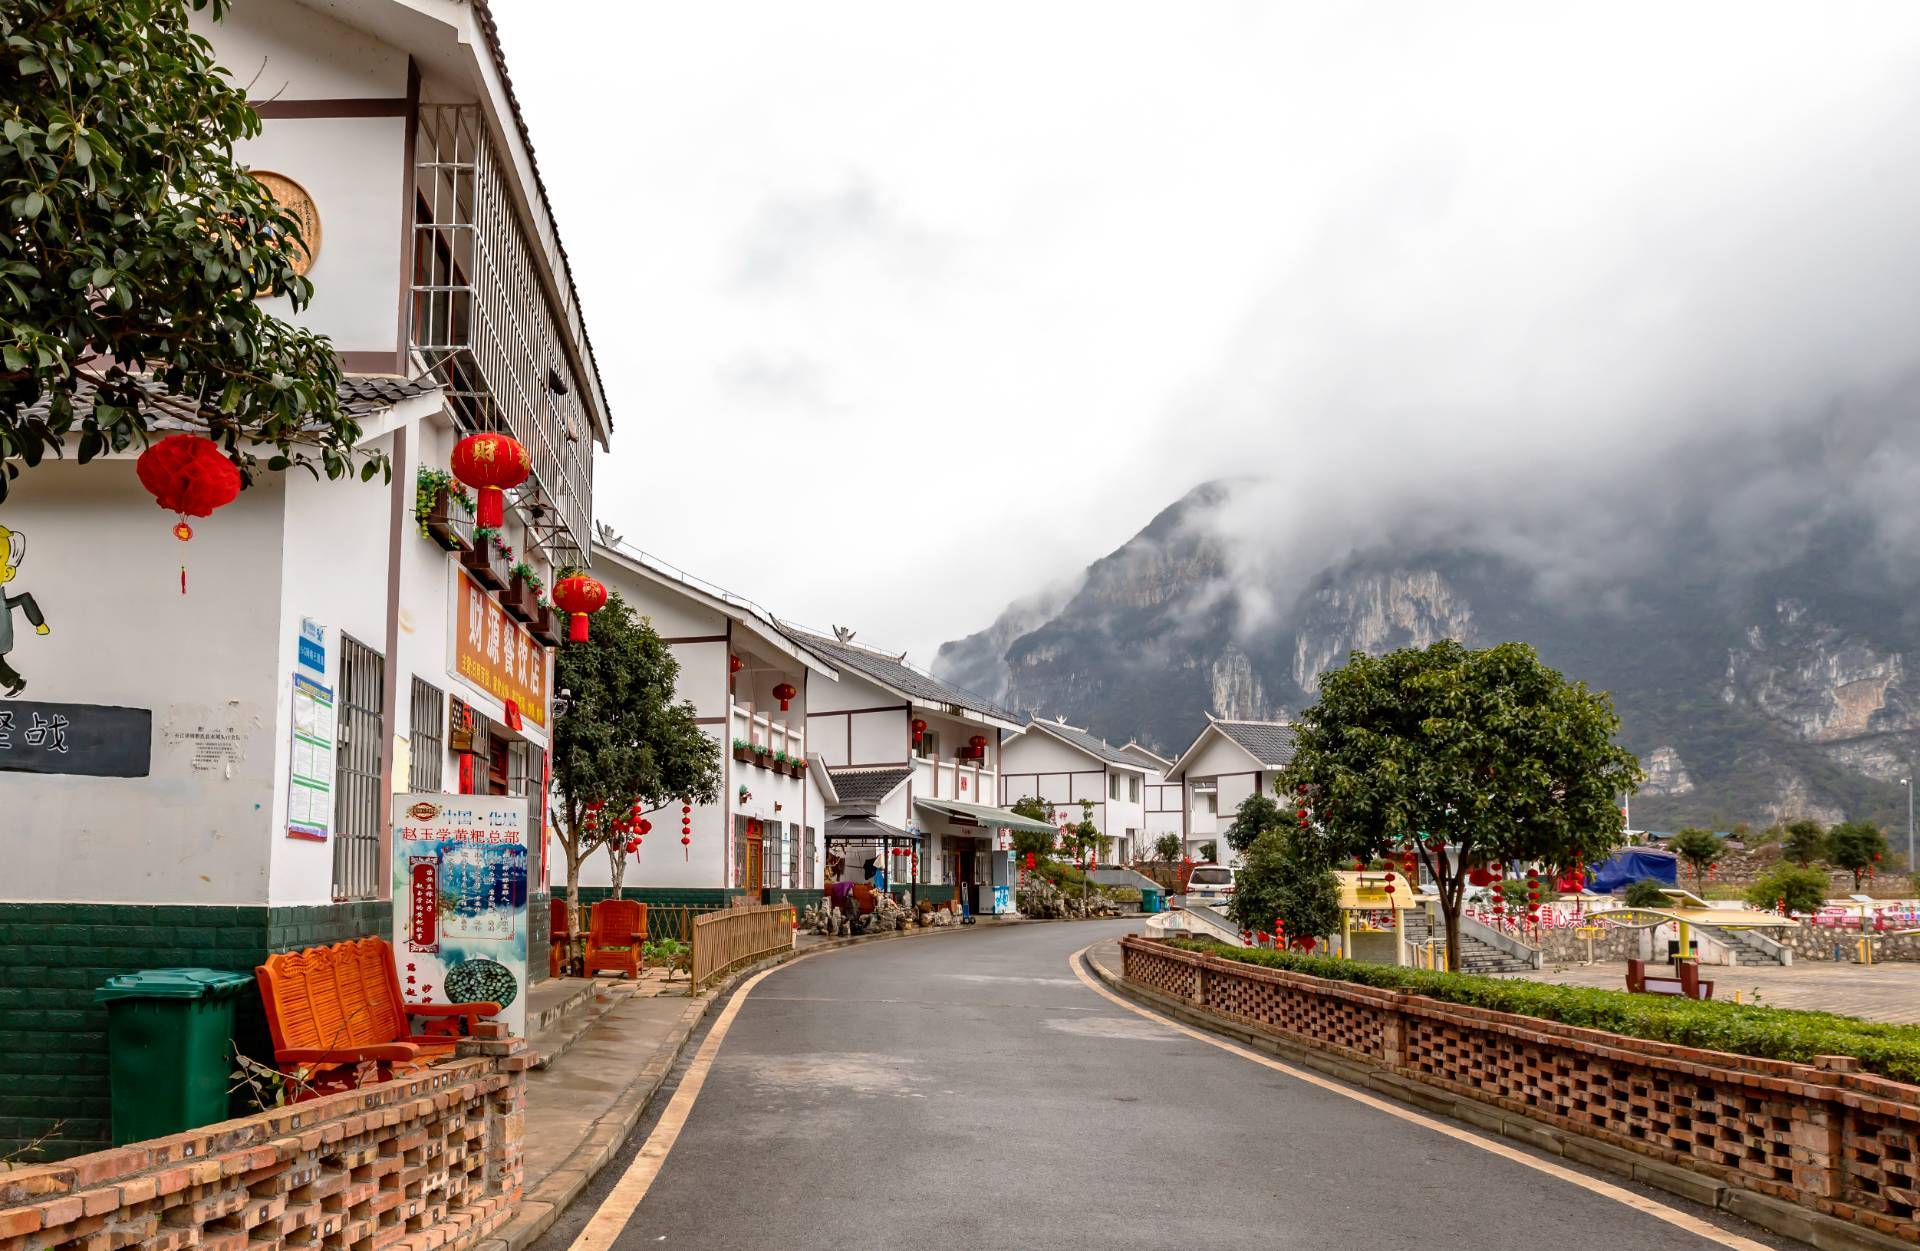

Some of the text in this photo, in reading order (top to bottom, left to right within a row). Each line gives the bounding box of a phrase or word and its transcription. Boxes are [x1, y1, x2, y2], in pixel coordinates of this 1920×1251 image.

[468, 585, 541, 697] 财源餐饮店
[402, 827, 520, 845] 赵玉学黄粑总部
